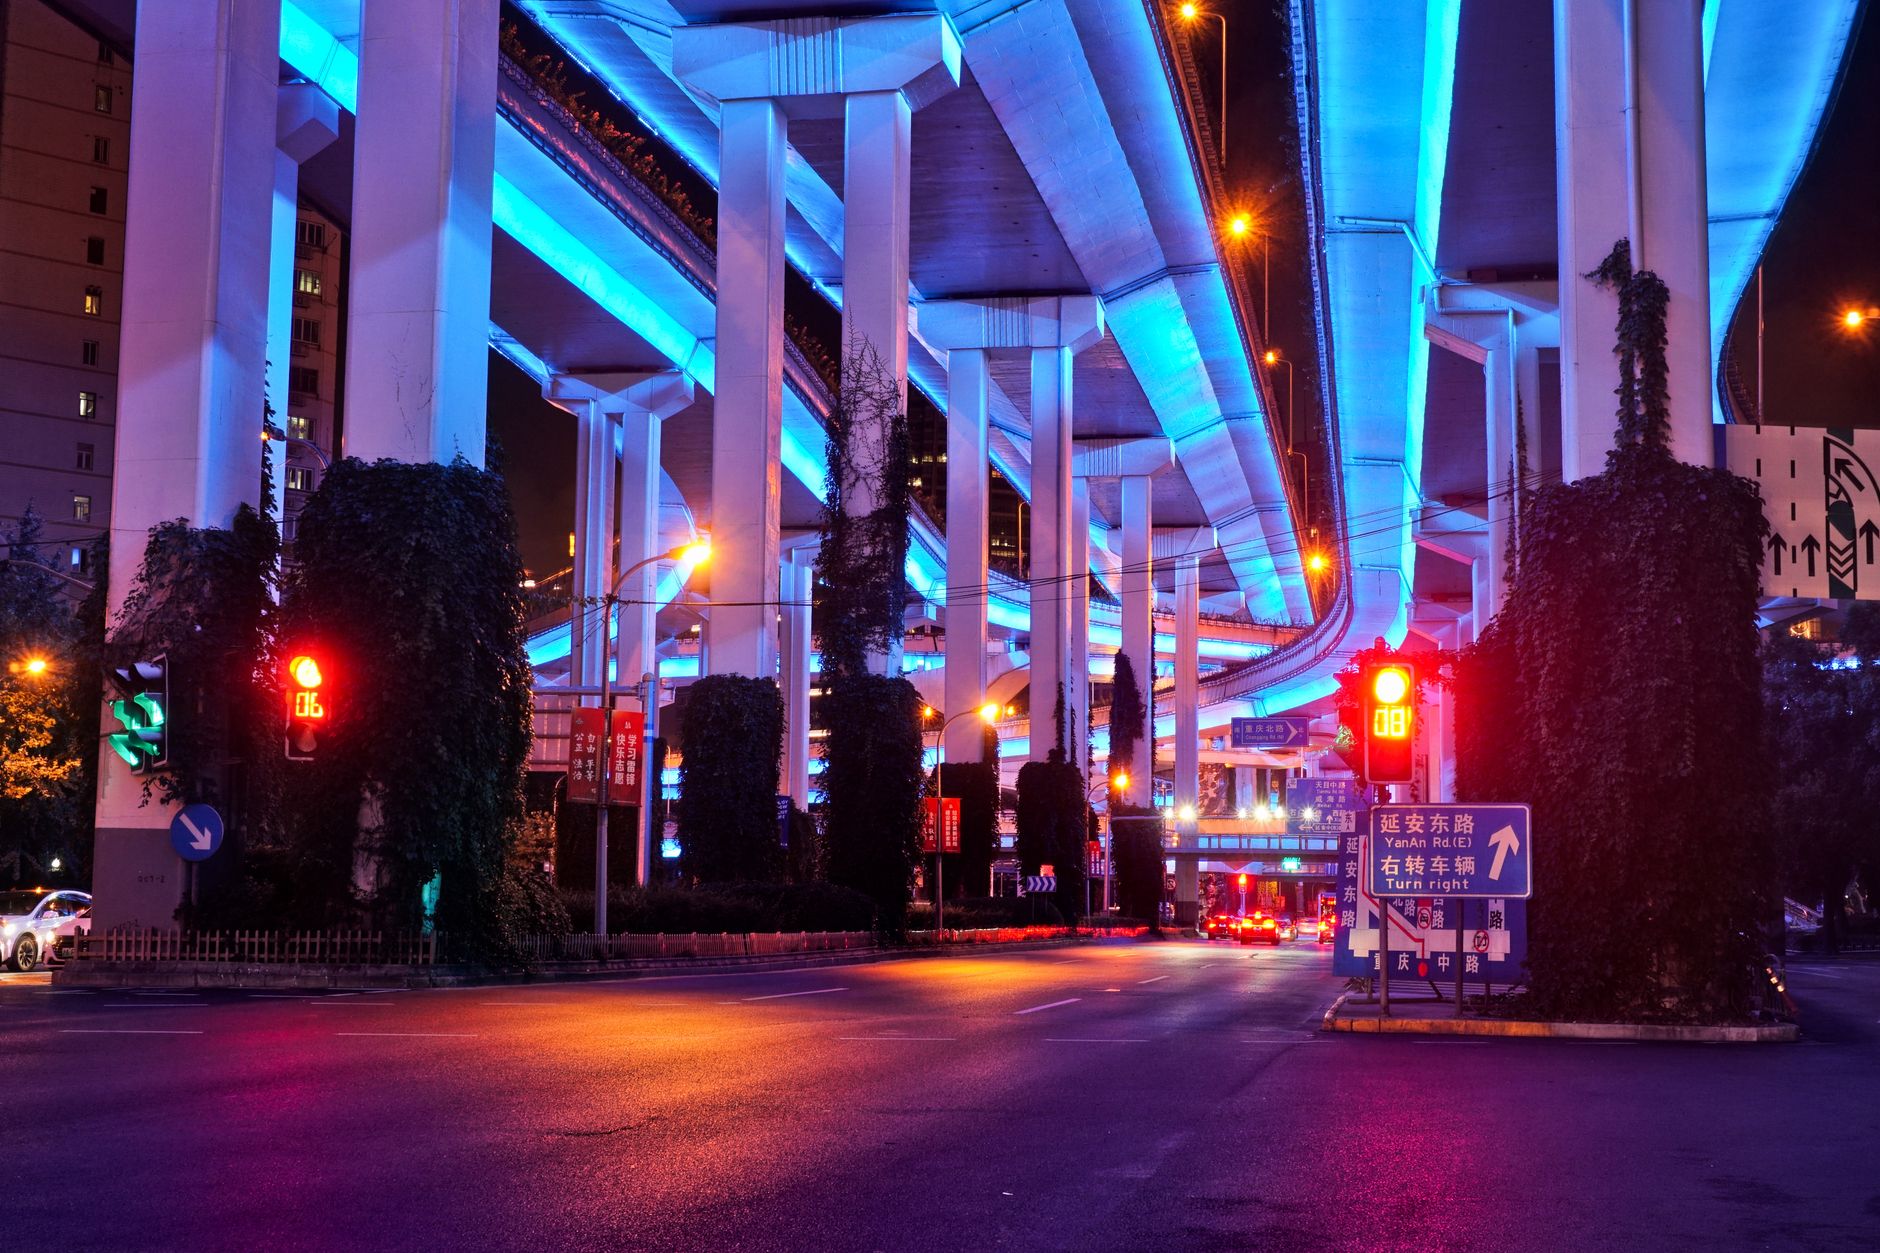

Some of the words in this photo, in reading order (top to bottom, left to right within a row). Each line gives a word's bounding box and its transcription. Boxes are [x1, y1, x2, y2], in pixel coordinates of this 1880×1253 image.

[296, 691, 324, 718] 06
[1245, 724, 1284, 733] 重庆北路
[1373, 708, 1406, 738] 08
[614, 733, 626, 785] 快乐志愿
[626, 734, 637, 786] 学习雷锋
[1315, 781, 1346, 789] 天目中路
[1380, 813, 1475, 834] 延安东路
[1385, 837, 1426, 848] YanAn
[1433, 837, 1472, 848] Rd.(E)
[1380, 855, 1475, 876] 右转车辆
[1340, 837, 1358, 928] 延安东路
[1386, 878, 1422, 889] Turn
[1430, 878, 1470, 892] right
